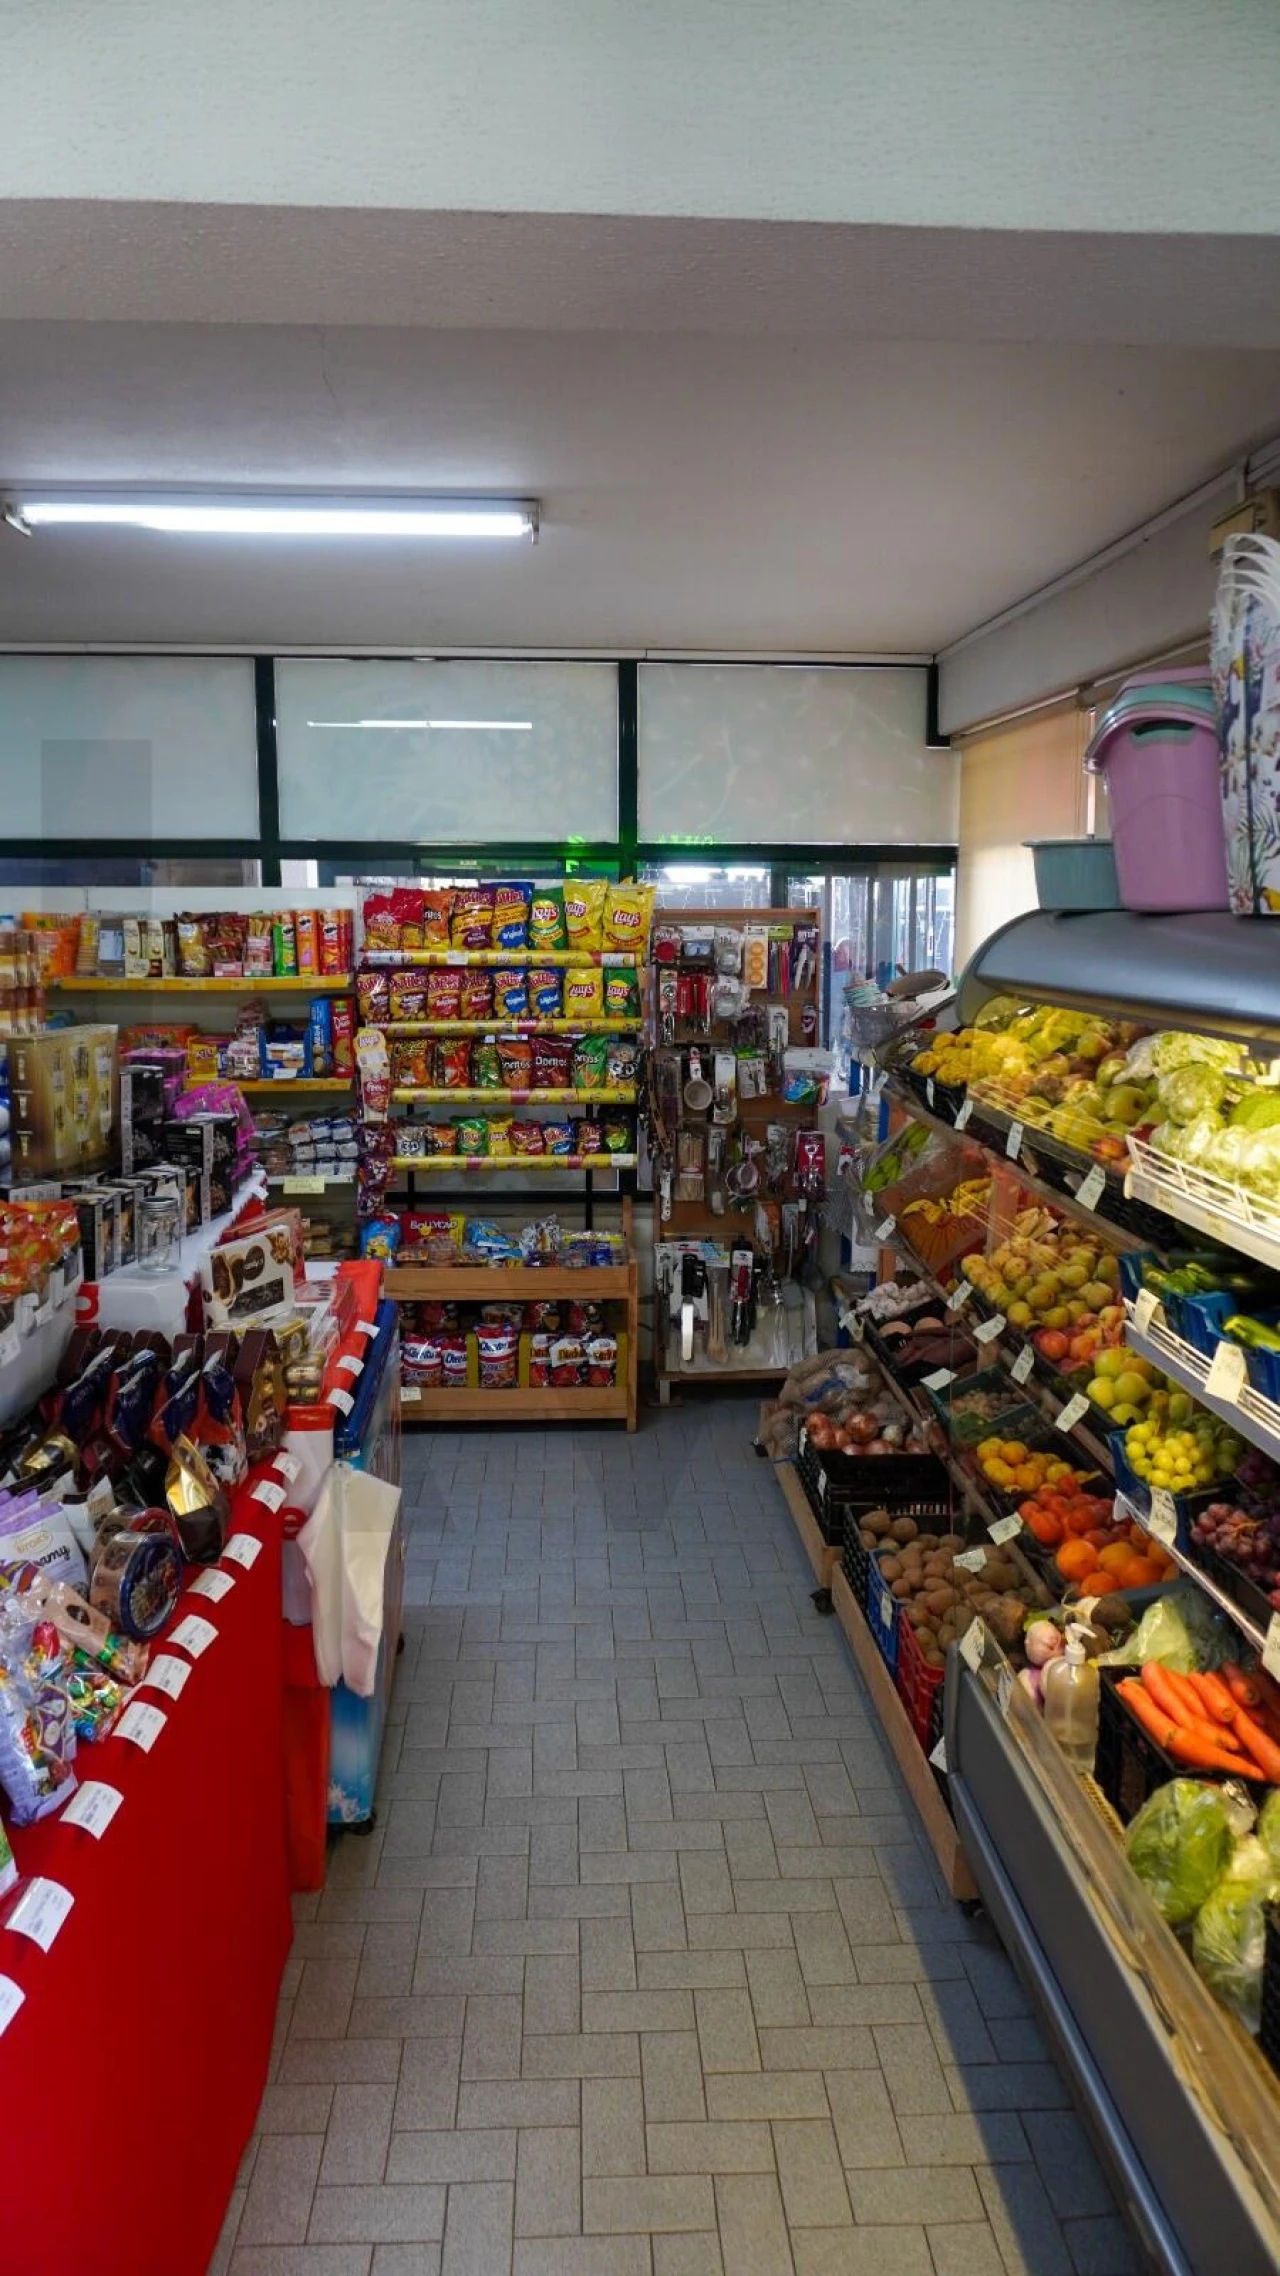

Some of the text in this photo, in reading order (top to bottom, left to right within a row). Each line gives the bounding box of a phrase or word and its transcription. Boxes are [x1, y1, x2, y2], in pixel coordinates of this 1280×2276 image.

[565, 903, 587, 916] ay's
[614, 909, 641, 925] Lay's
[569, 984, 594, 998] Lay's
